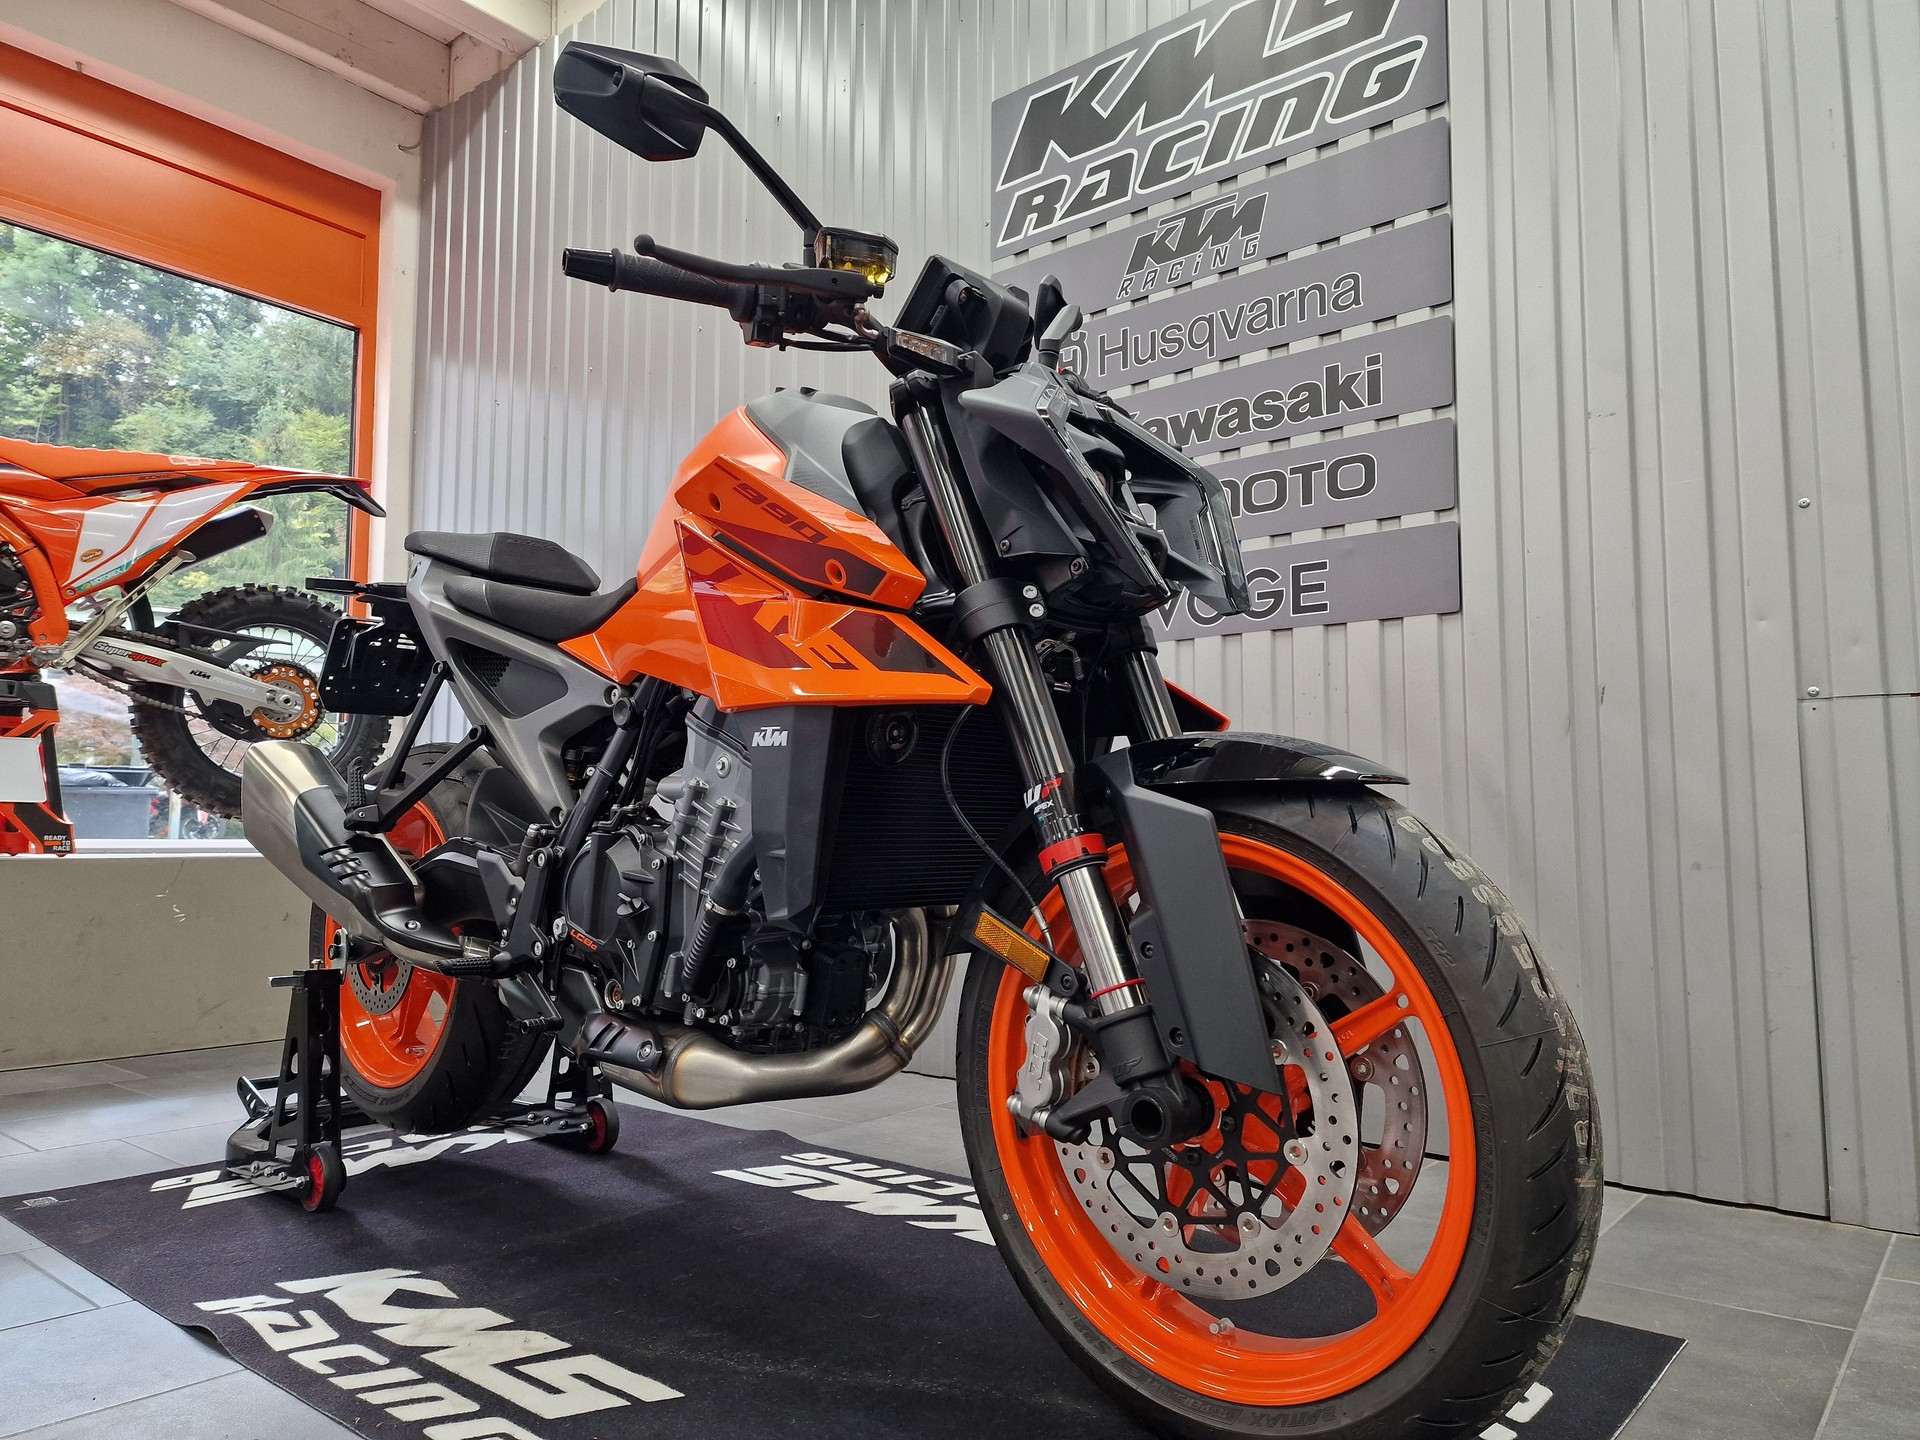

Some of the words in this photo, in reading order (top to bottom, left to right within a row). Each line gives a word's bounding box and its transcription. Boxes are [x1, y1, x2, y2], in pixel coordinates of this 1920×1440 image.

[1124, 192, 1269, 276] KTM
[1098, 271, 1363, 378] Husqvarna
[1129, 352, 1383, 448] awasaki
[732, 481, 829, 544] 990
[89, 568, 125, 586] MOTOREX
[189, 669, 212, 680] KTM
[211, 676, 258, 693] POWERPARTS
[751, 725, 789, 747] KTM
[1023, 777, 1062, 810] WP
[1033, 799, 1055, 815] APEX
[274, 1268, 685, 1419] KMS
